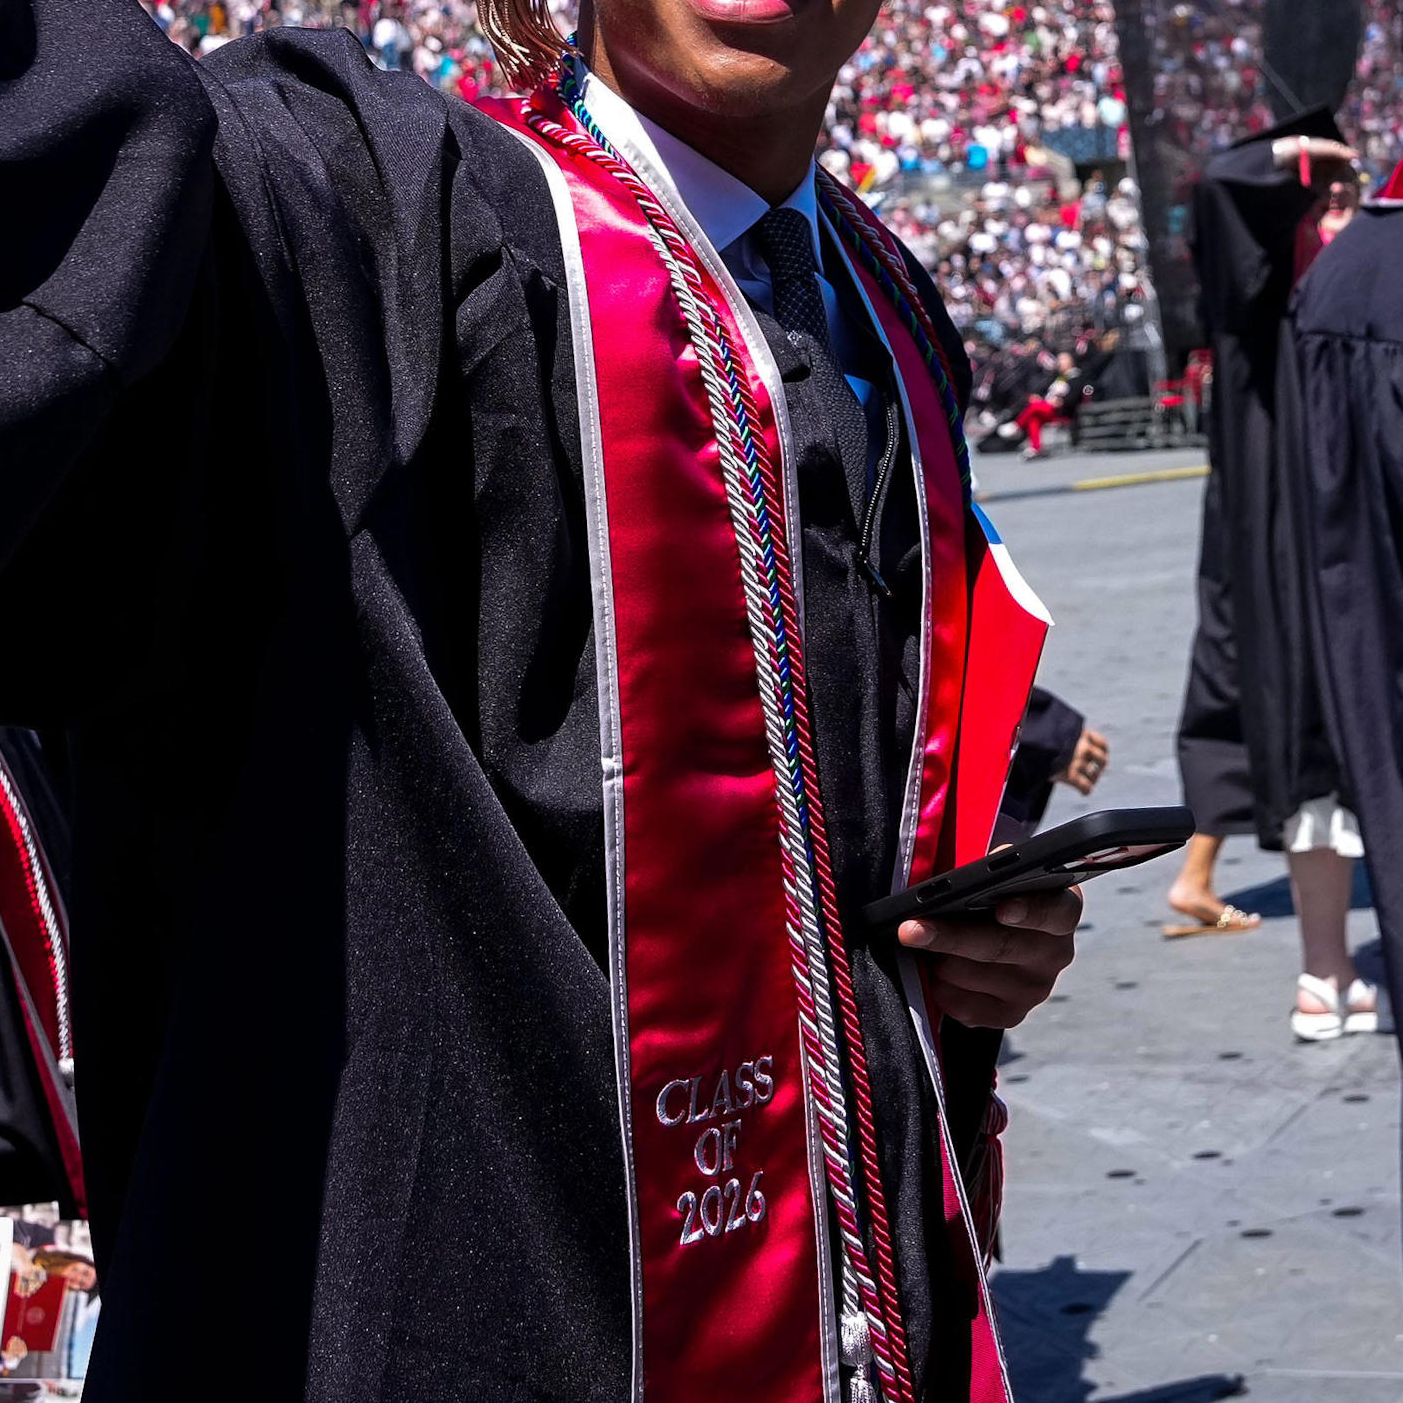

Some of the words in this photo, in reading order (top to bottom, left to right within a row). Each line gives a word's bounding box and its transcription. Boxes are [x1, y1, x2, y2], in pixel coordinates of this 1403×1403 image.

[655, 1054, 774, 1127] CLASS
[693, 1118, 742, 1177] OF
[676, 1170, 766, 1246] 2026
